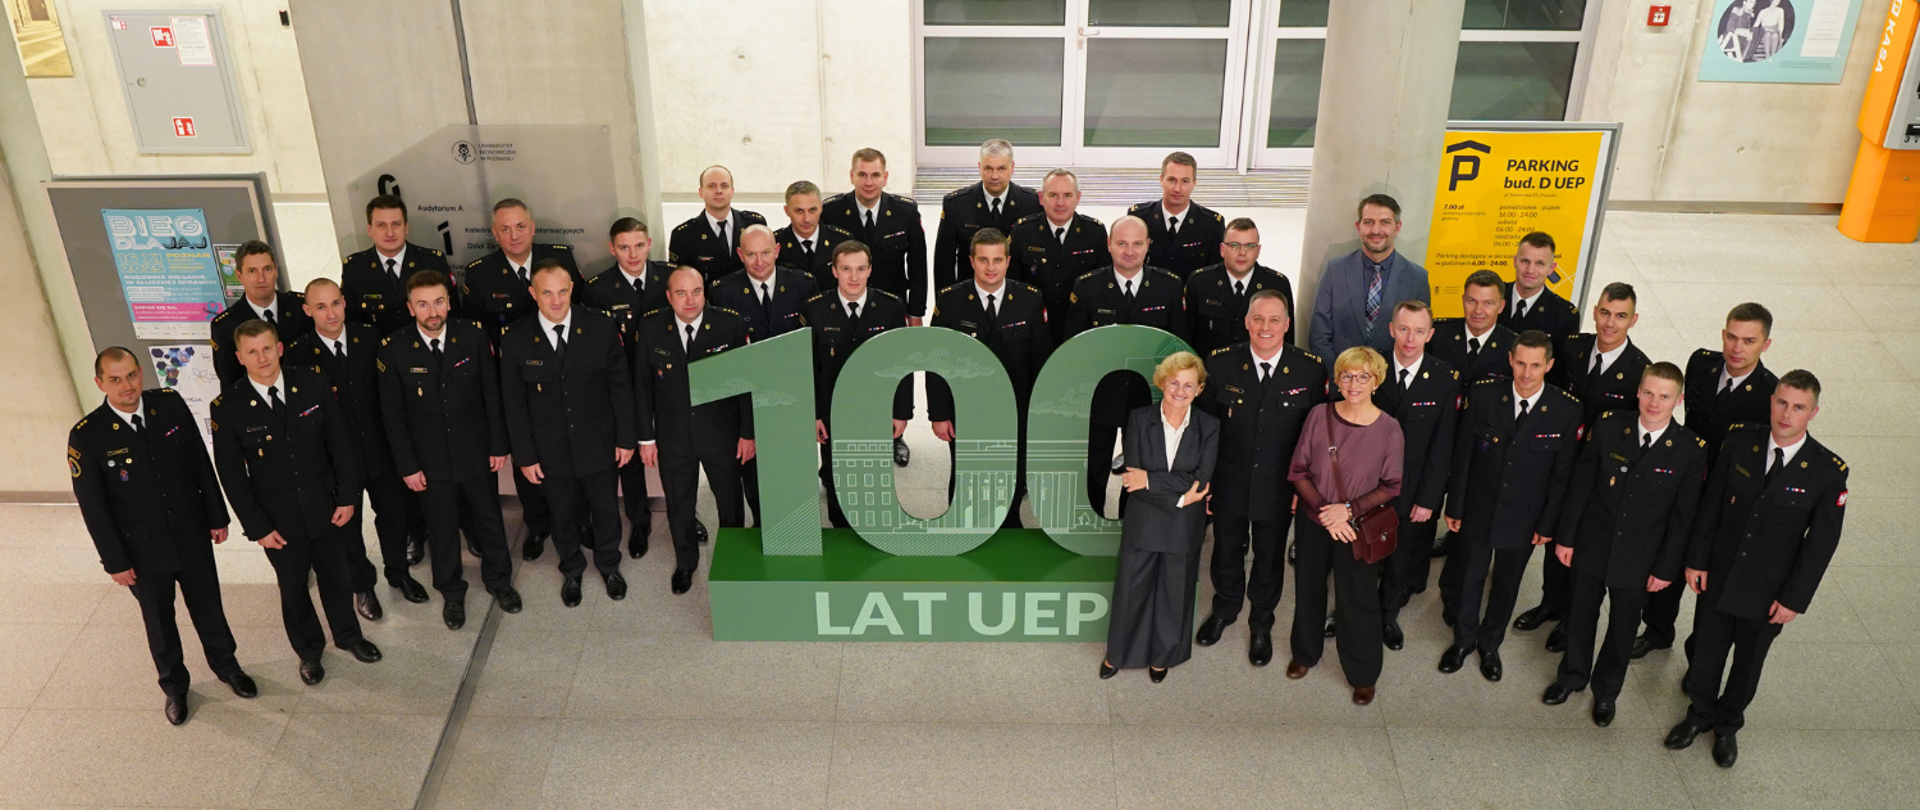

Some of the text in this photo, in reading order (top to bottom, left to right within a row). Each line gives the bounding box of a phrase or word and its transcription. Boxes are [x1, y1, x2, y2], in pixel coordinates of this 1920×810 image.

[1875, 18, 1896, 72] KASA
[1506, 159, 1580, 172] PARKING
[1503, 176, 1586, 189] bud. D UEP
[107, 215, 203, 237] BIEG
[688, 324, 1204, 556] 100
[814, 591, 1109, 636] LAT UEP
